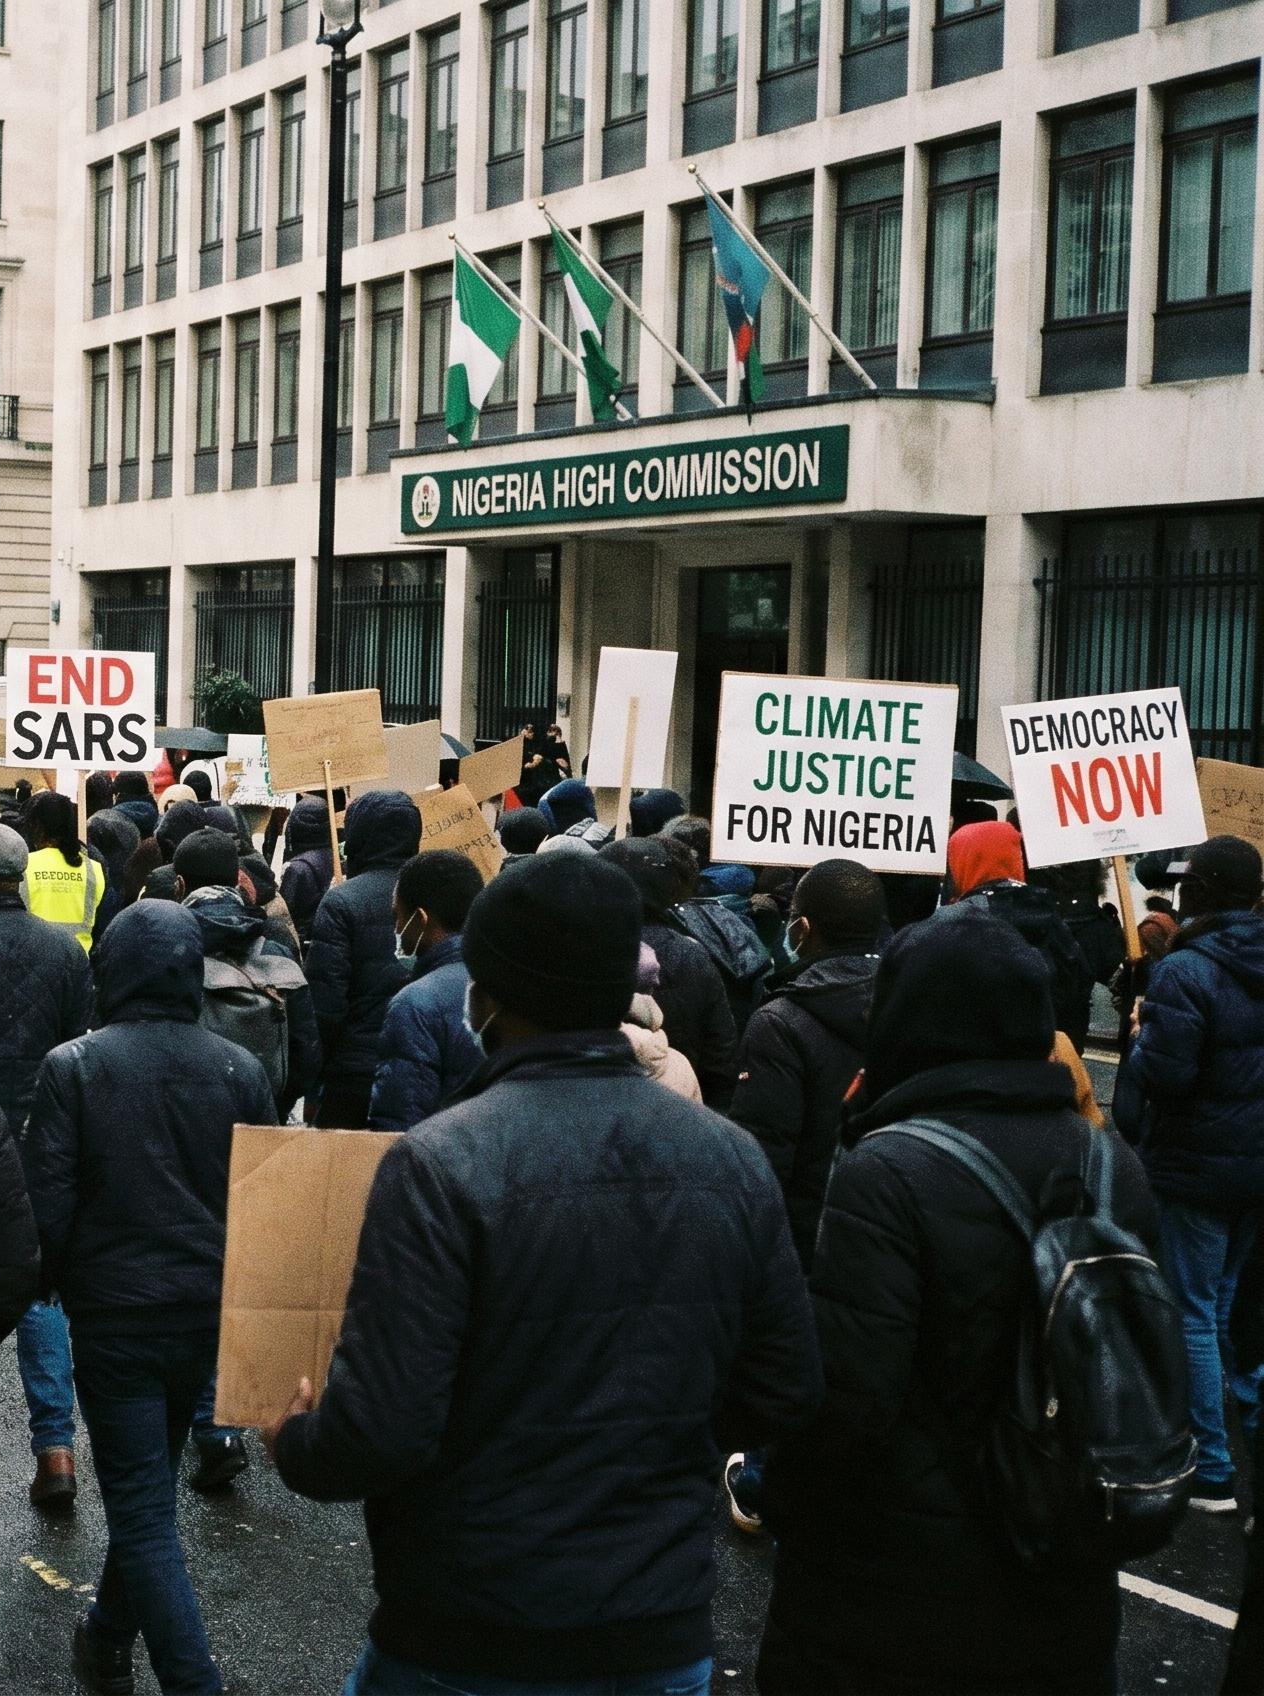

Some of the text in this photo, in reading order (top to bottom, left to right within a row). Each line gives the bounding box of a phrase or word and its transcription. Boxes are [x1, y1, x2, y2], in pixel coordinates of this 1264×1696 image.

[451, 441, 820, 517] NIGERIA HIGH COMMISSION
[28, 655, 134, 706] END
[12, 710, 148, 762] SARS
[755, 691, 923, 745] CLIMATE
[1010, 700, 1182, 756] DEMOCRACY
[753, 749, 916, 800] JUSTICE
[1050, 751, 1163, 827] NOW
[727, 803, 936, 854] FOR NIGERIA
